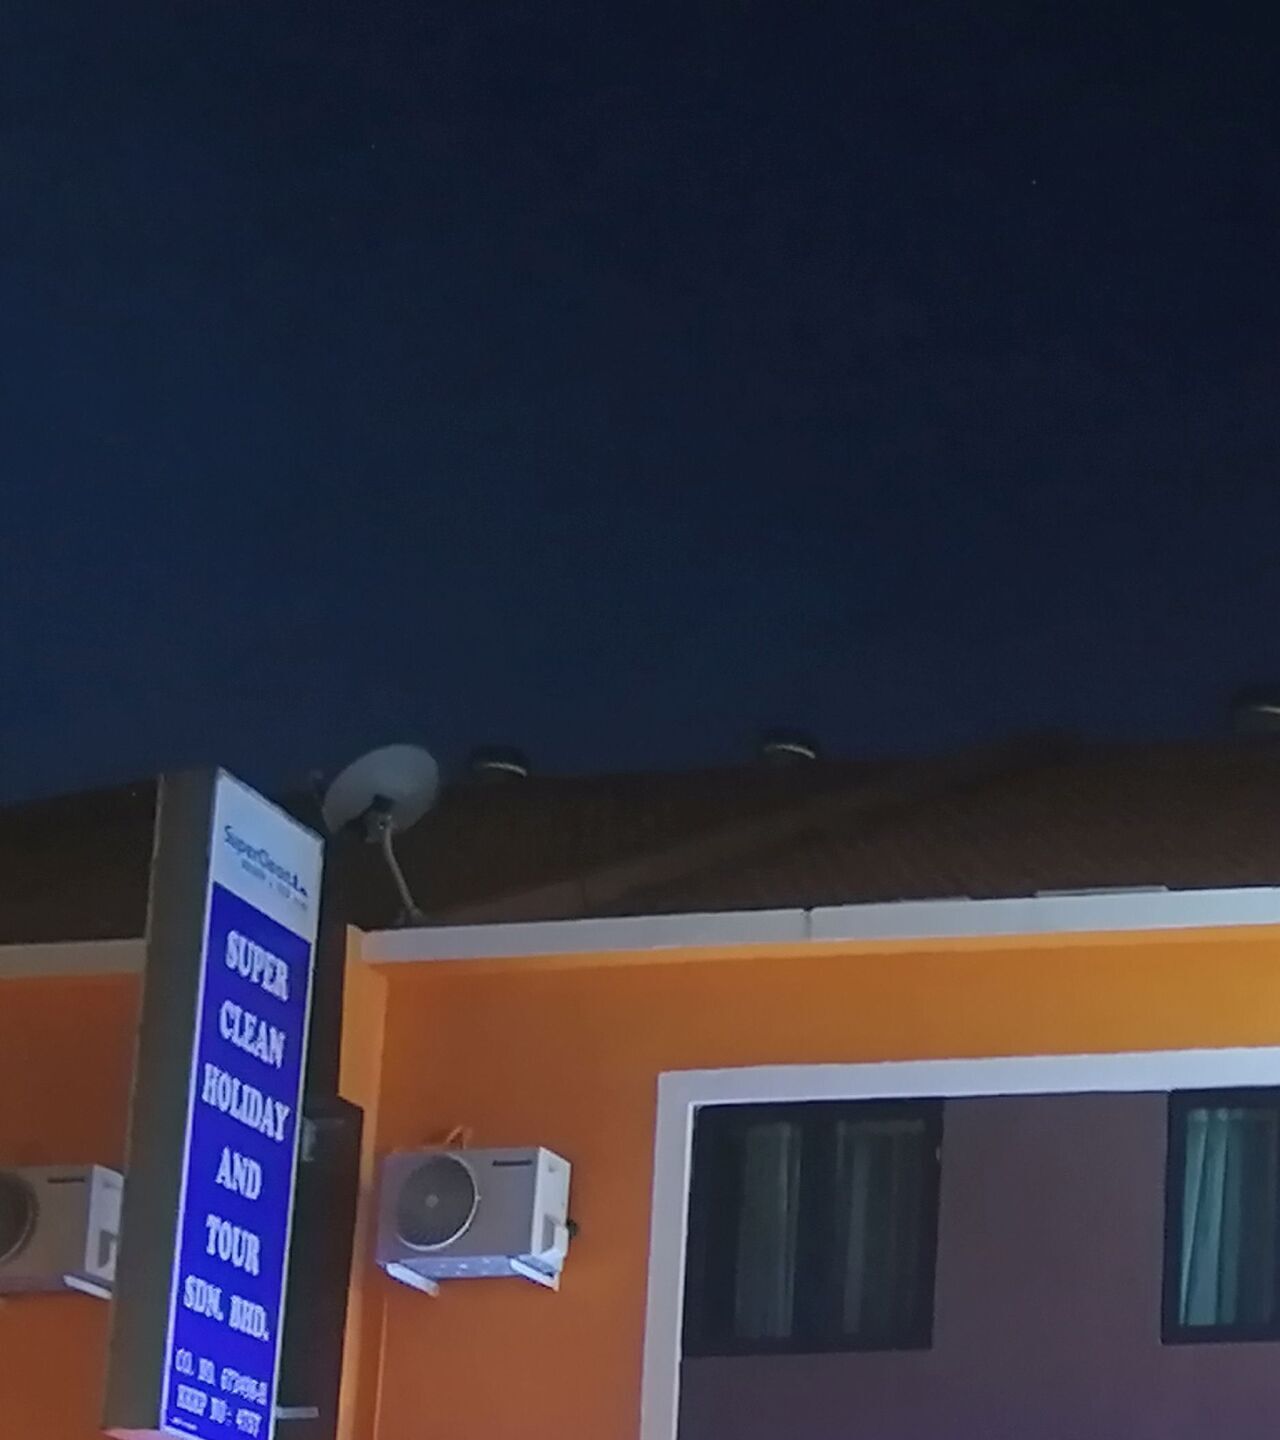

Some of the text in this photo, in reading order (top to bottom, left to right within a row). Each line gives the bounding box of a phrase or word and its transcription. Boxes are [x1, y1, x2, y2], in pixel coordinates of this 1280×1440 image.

[225, 929, 290, 1003] SUPER
[219, 999, 286, 1070] CLEAN
[201, 1061, 290, 1143] HOLIDAY
[215, 1145, 263, 1201] AND
[205, 1213, 260, 1277] TOUR
[183, 1274, 270, 1342] SDN. BHD.
